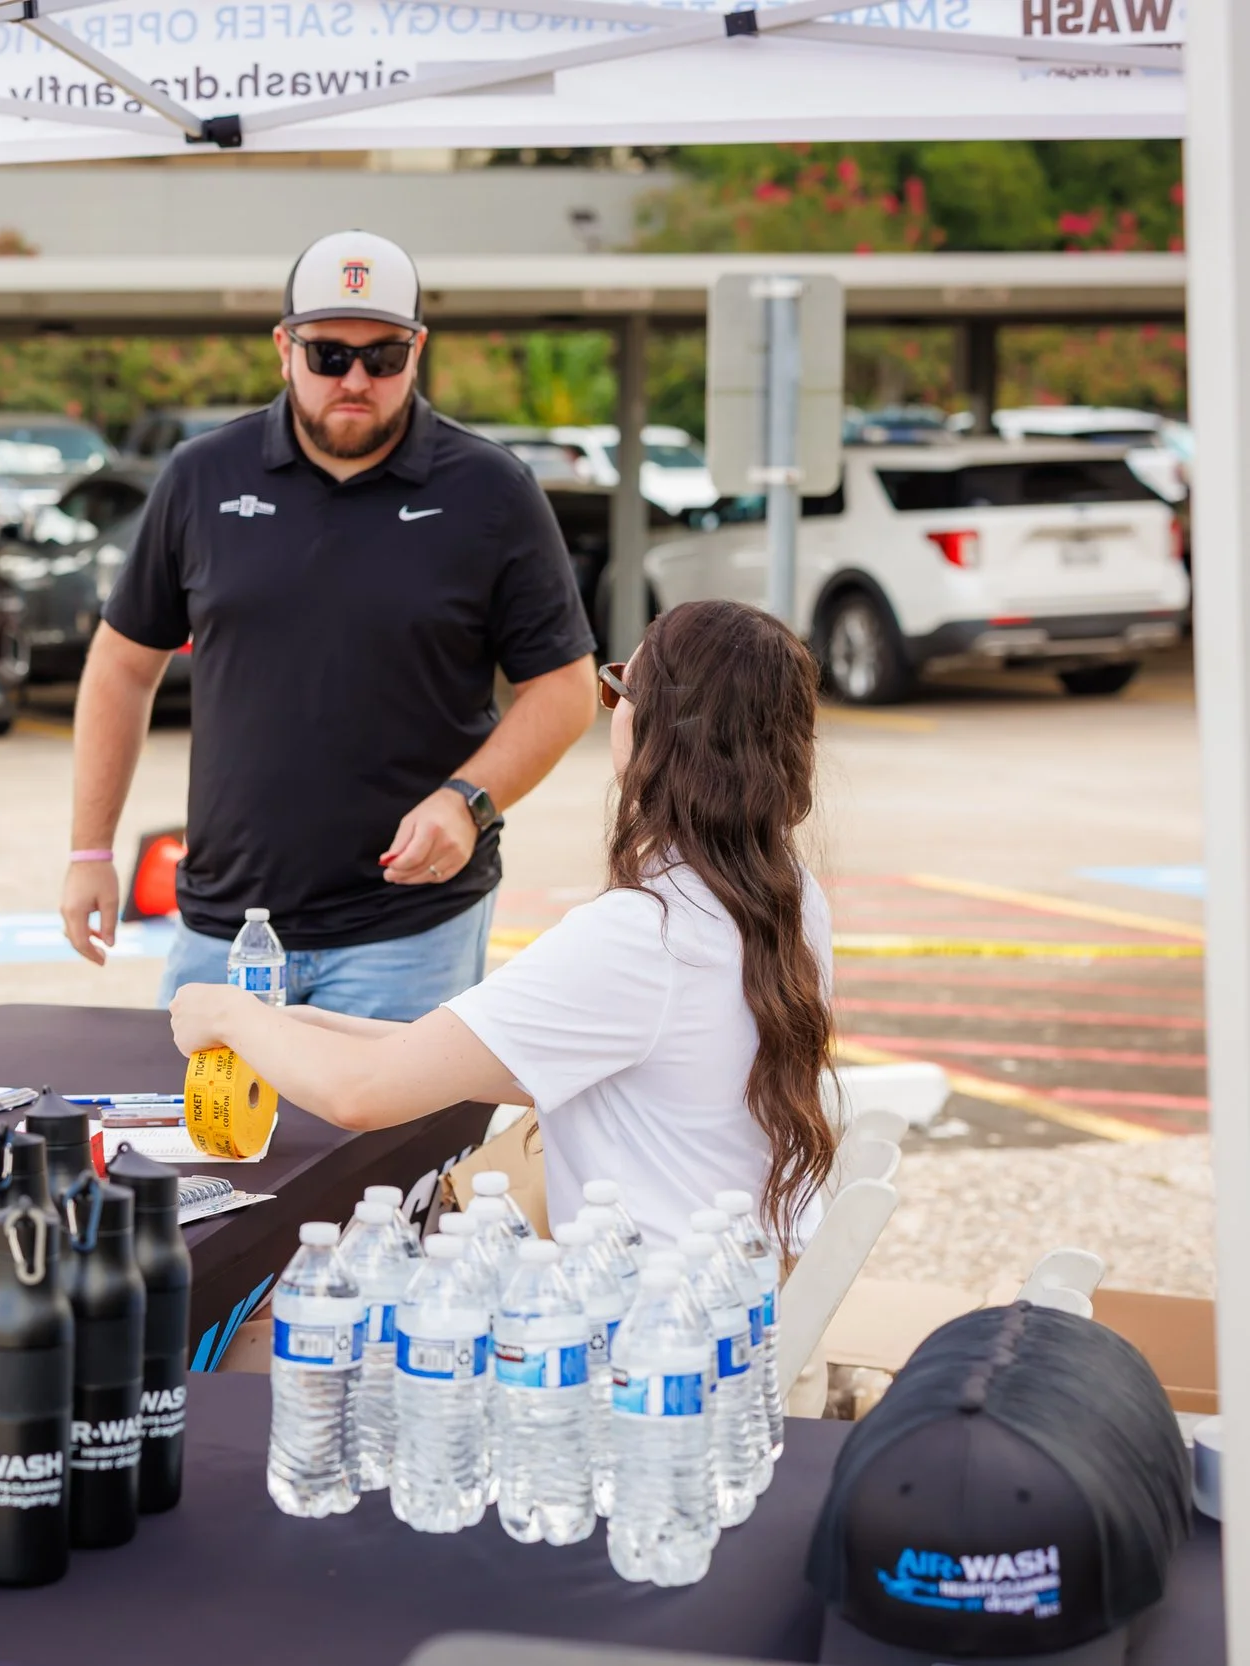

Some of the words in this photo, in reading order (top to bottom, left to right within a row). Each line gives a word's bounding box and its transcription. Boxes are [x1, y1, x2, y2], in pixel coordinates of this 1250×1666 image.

[195, 1052, 207, 1076] TICKET
[226, 1050, 234, 1080] COUPON
[193, 1093, 202, 1122] TICKET
